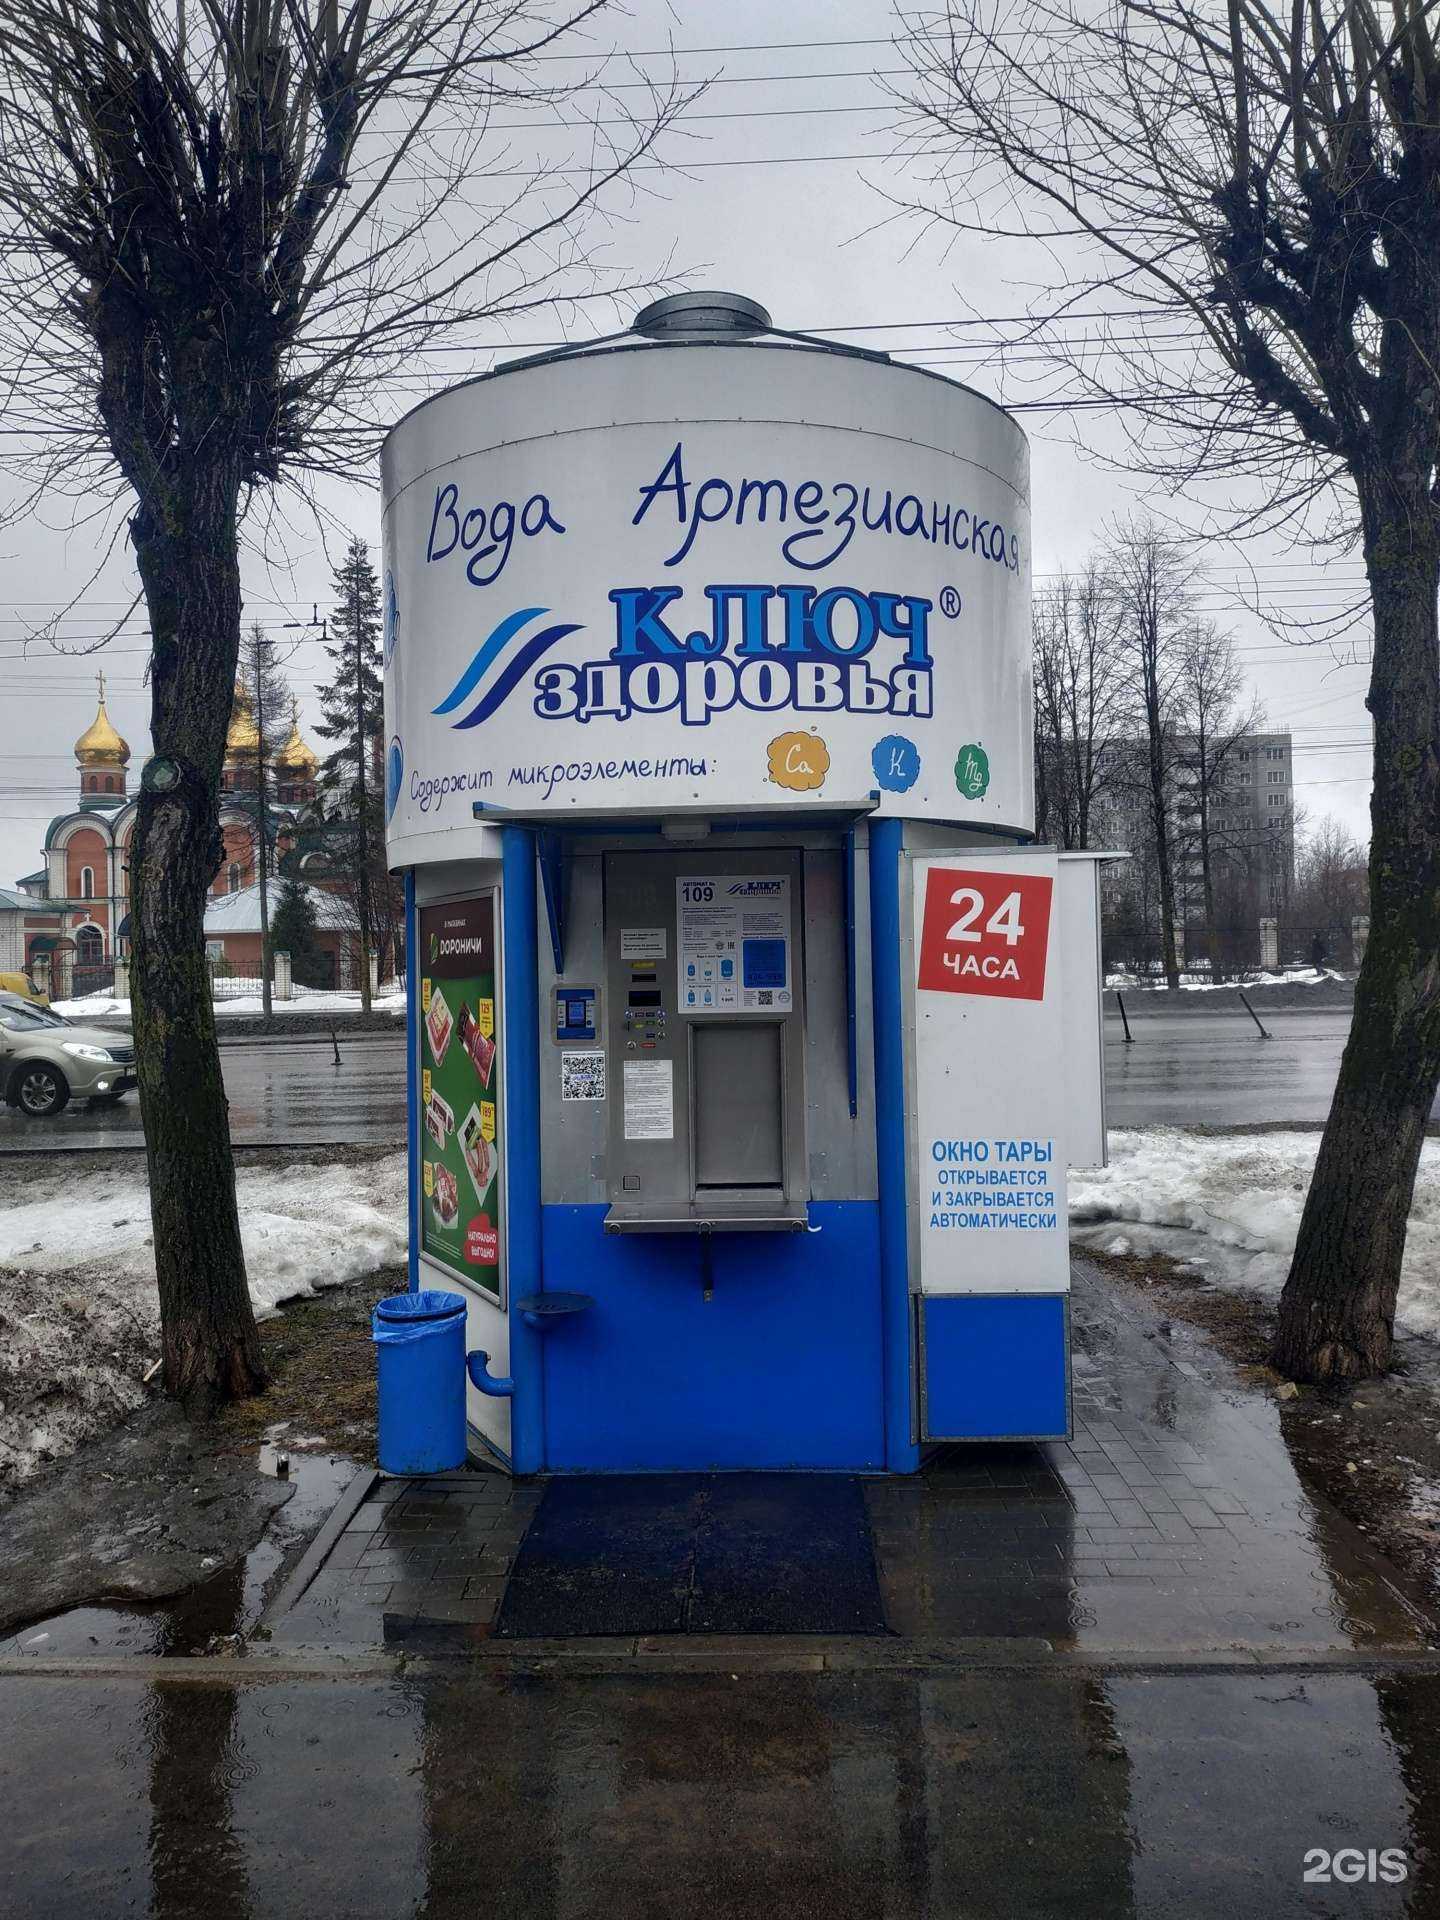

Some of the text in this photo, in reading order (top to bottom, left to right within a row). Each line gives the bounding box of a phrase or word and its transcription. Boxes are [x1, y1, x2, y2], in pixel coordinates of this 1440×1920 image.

[427, 441, 1020, 587] Вода Артезианская
[609, 585, 933, 667] КЛЮЧ
[534, 658, 934, 727] здоровья
[410, 757, 717, 812] Содержит микроэлементы:
[682, 887, 714, 902] 109
[945, 887, 1025, 946] 24
[943, 952, 1020, 981] ЧАСА
[931, 1140, 1053, 1163] ОКНО ТАРЫ
[938, 1168, 1048, 1186] ОТКРЫВАЕТСЯ
[931, 1190, 1055, 1208] И ЗАКРЫВАЕТСЯ
[929, 1212, 1057, 1230] АВТОМАТИЧЕСКИ
